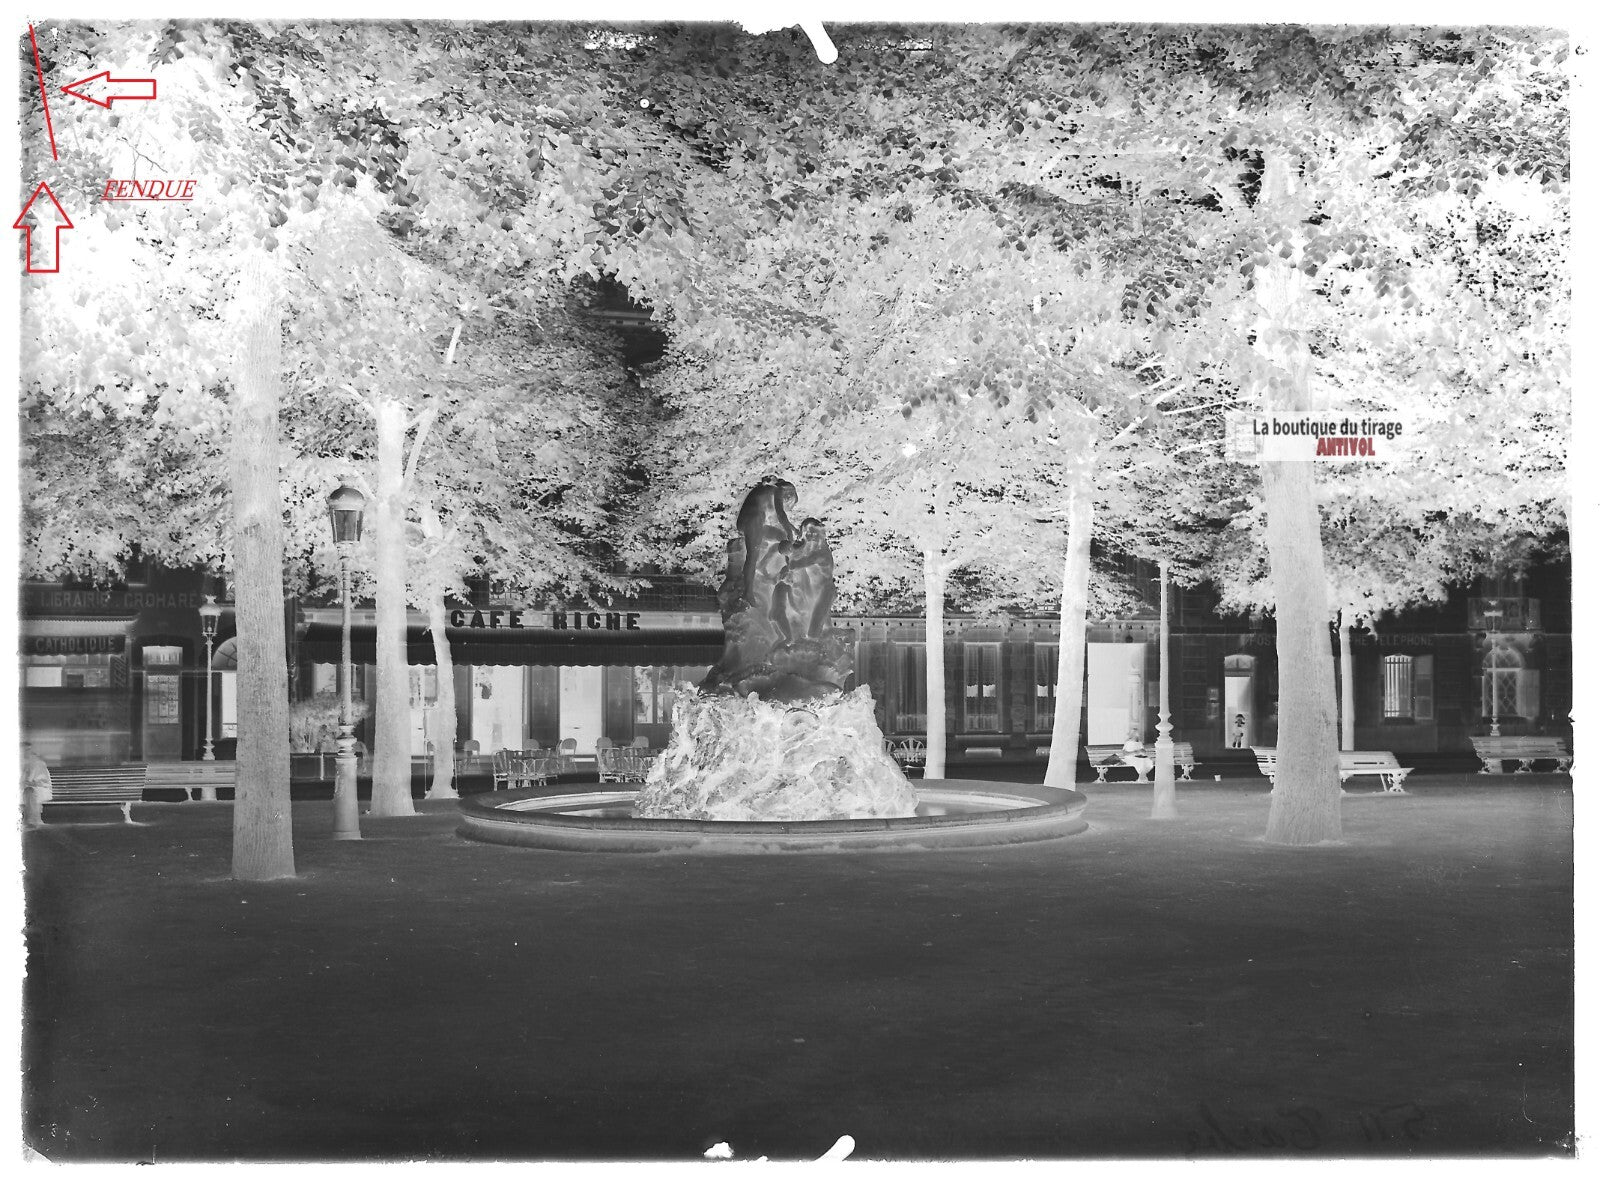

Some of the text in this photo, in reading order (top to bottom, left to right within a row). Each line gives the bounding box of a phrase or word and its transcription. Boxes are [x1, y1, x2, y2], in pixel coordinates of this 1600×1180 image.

[450, 609, 641, 630] CAFE RICHE
[35, 635, 116, 652] CATHOLIQUE
